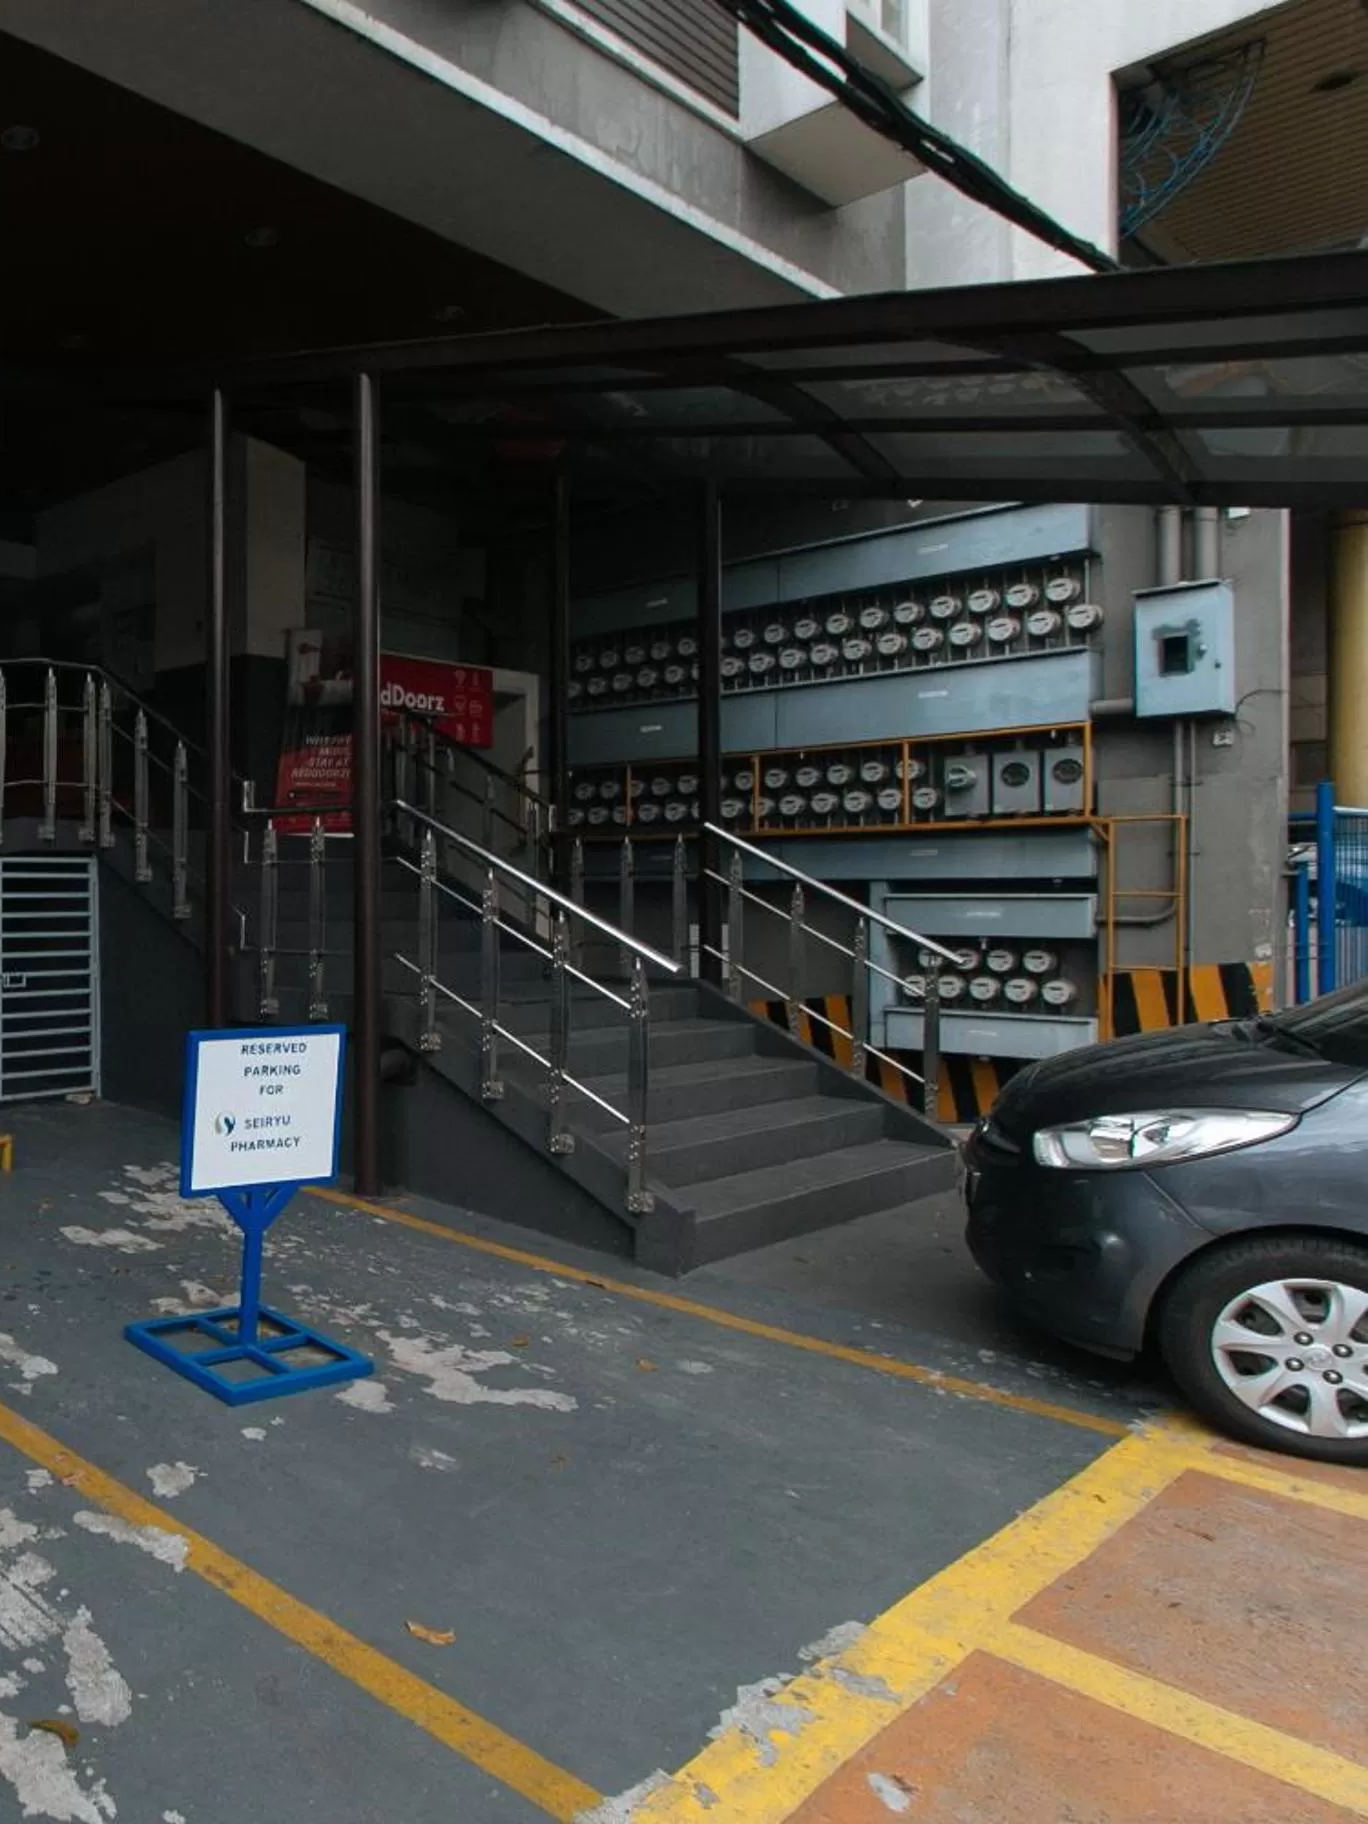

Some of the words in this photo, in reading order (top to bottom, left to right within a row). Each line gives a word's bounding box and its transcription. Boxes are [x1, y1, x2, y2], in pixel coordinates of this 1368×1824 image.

[381, 680, 445, 712] dDoorz
[240, 1042, 308, 1056] RESERVED
[243, 1064, 301, 1077] PARKING
[258, 1084, 284, 1096] FOR
[244, 1114, 291, 1130] SEIRYU
[230, 1135, 301, 1152] PHARMACY
